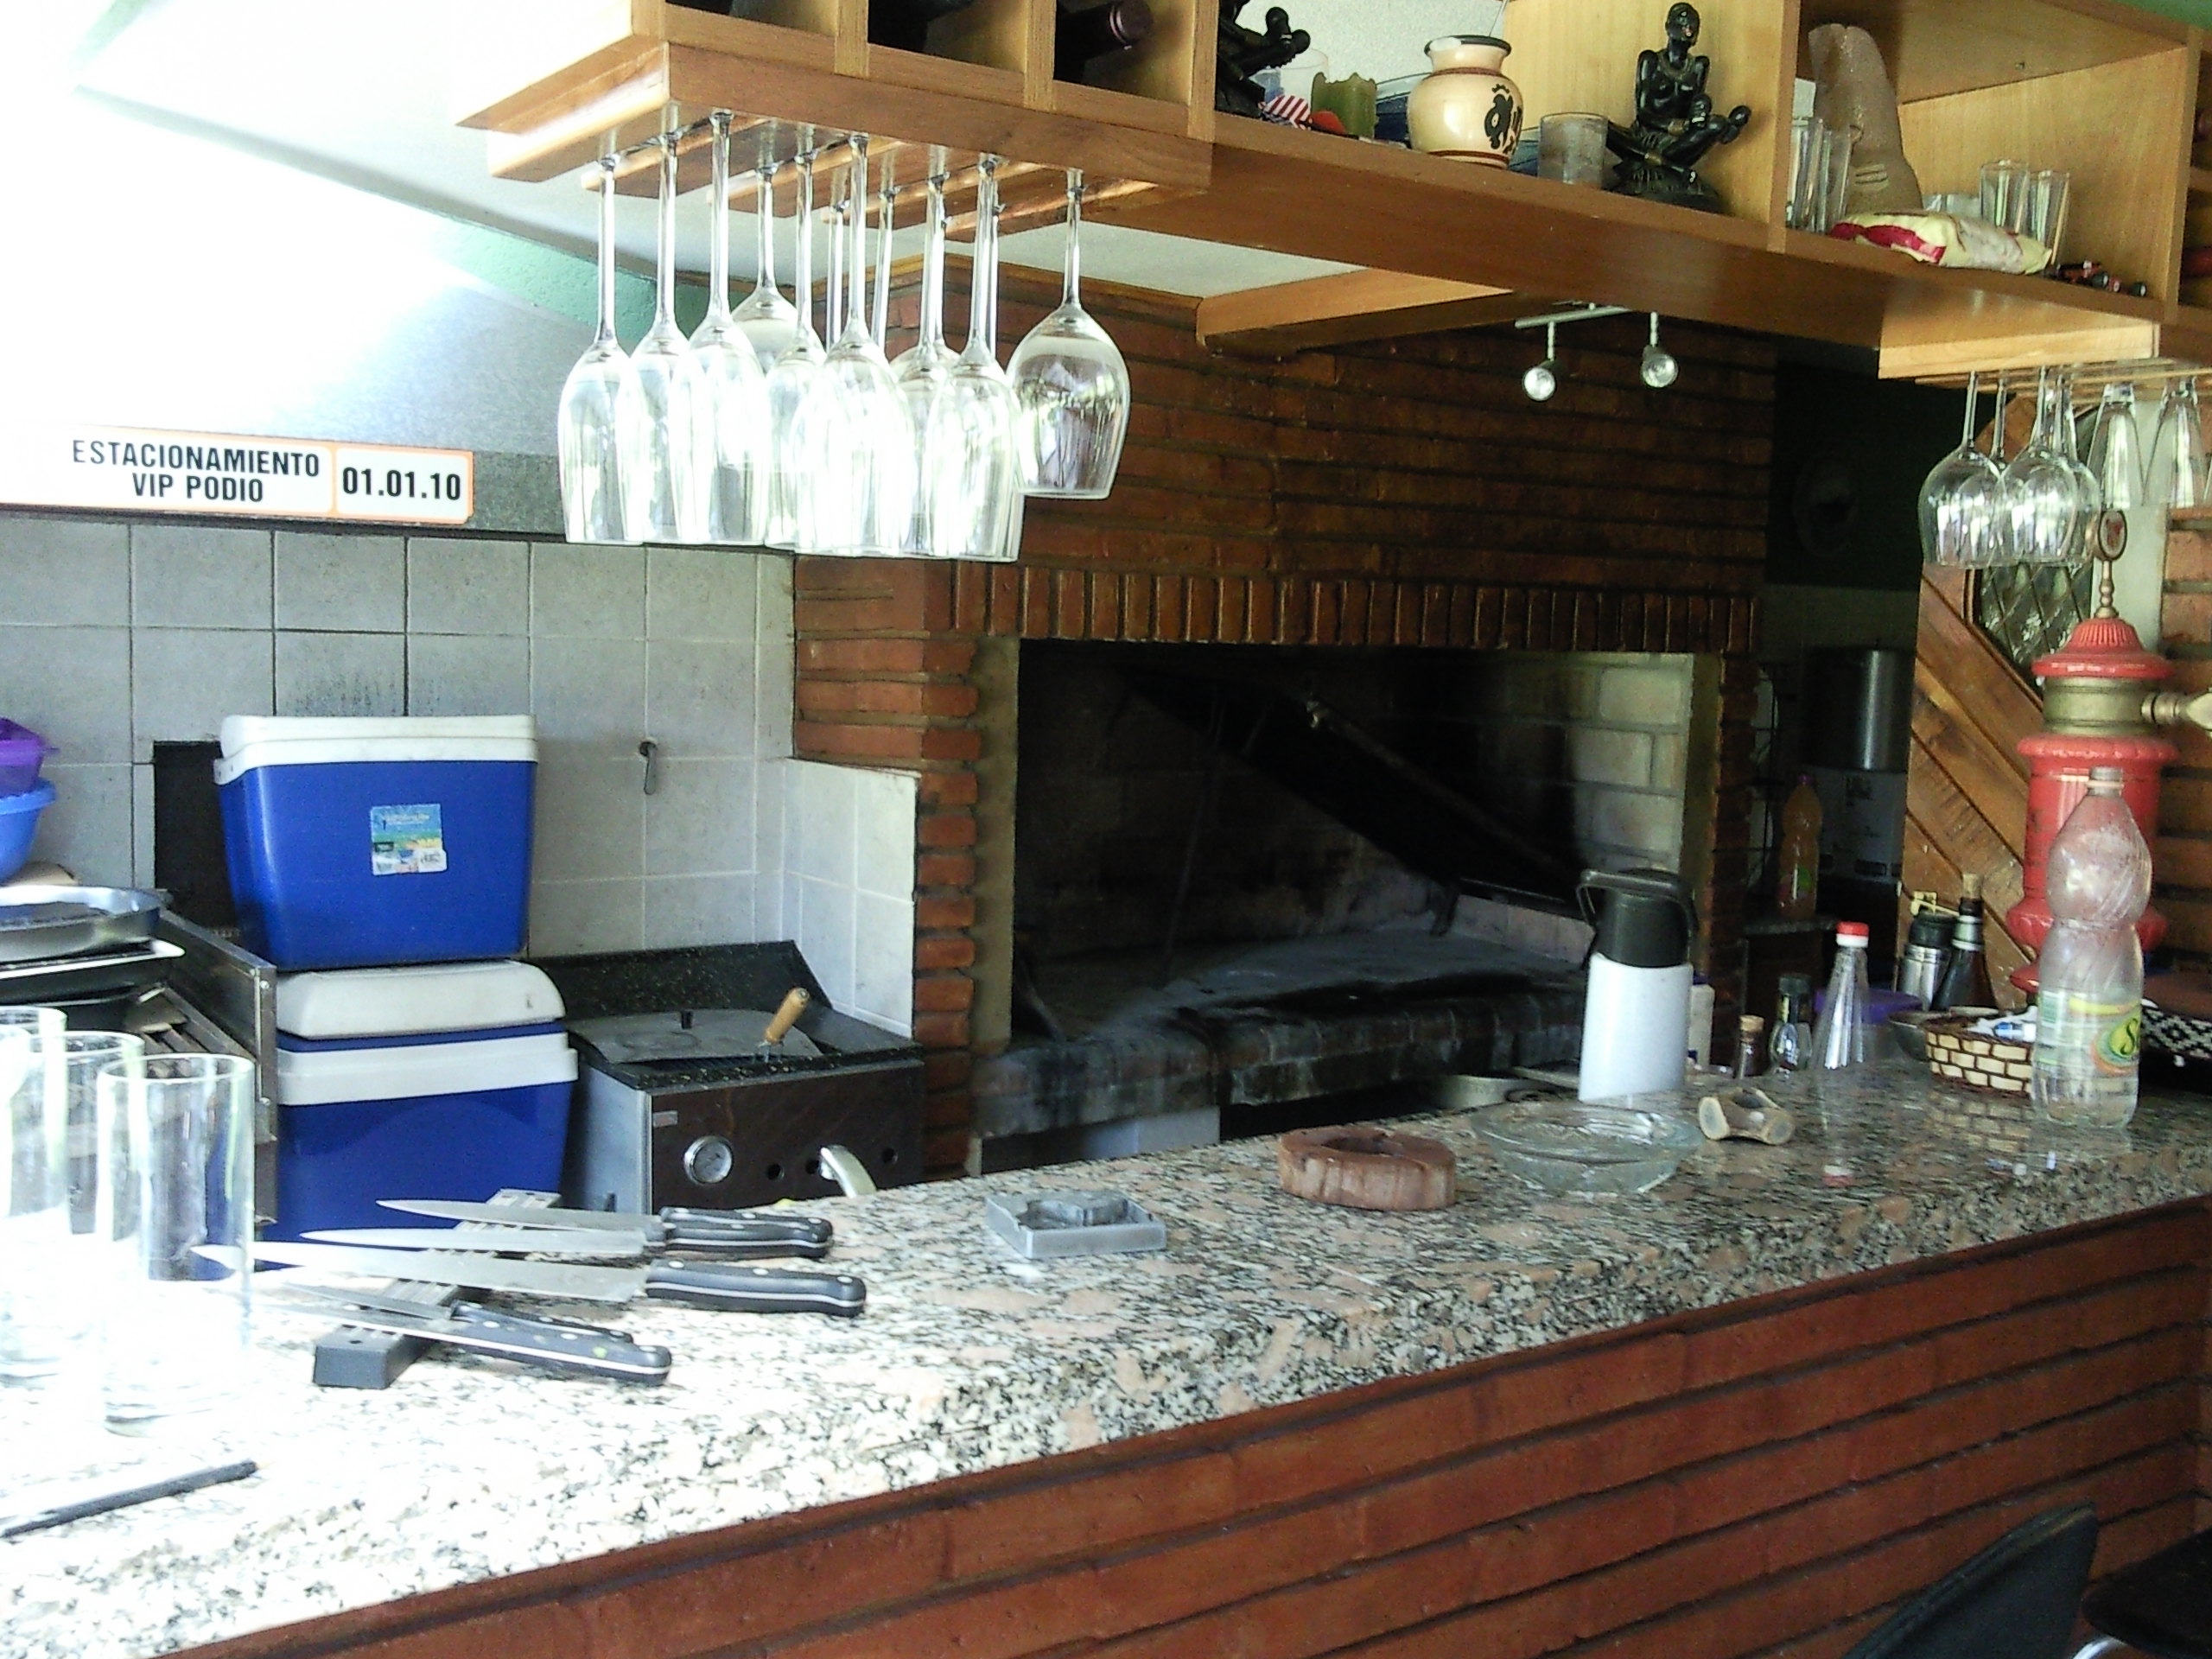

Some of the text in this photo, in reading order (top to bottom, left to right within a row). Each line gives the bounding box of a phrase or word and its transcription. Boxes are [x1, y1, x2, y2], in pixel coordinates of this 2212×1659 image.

[73, 440, 319, 477] ESTACIONAMIENTO
[132, 473, 263, 502] VIP PODIO
[342, 467, 461, 500] 01.01.10
